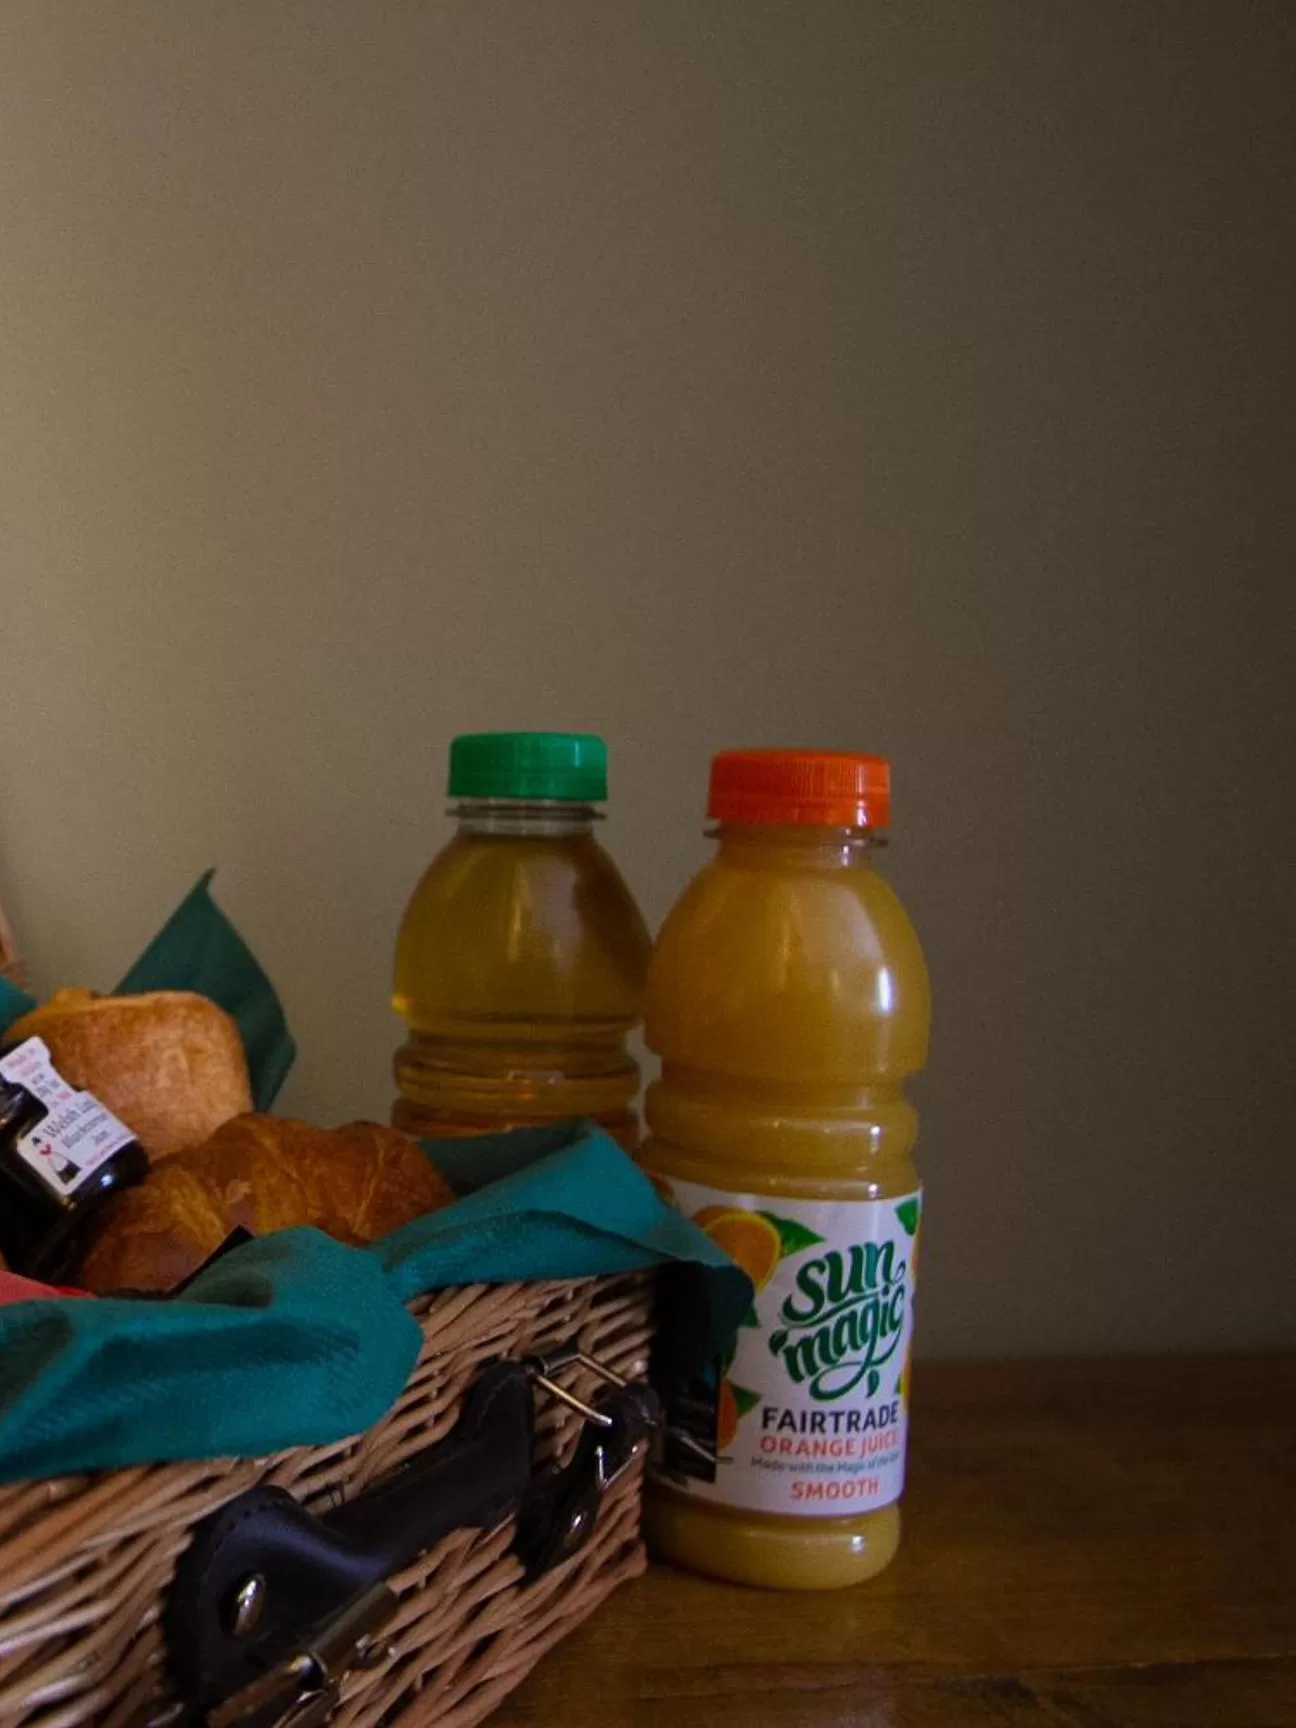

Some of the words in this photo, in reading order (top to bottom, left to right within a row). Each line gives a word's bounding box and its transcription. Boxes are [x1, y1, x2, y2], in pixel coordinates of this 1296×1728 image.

[782, 1240, 904, 1326] sun
[769, 1284, 906, 1400] magic
[761, 1401, 900, 1435] FAIRTRADE
[760, 1435, 856, 1458] ORANGE
[860, 1429, 899, 1459] JUICE
[791, 1476, 881, 1501] SMOOTH
